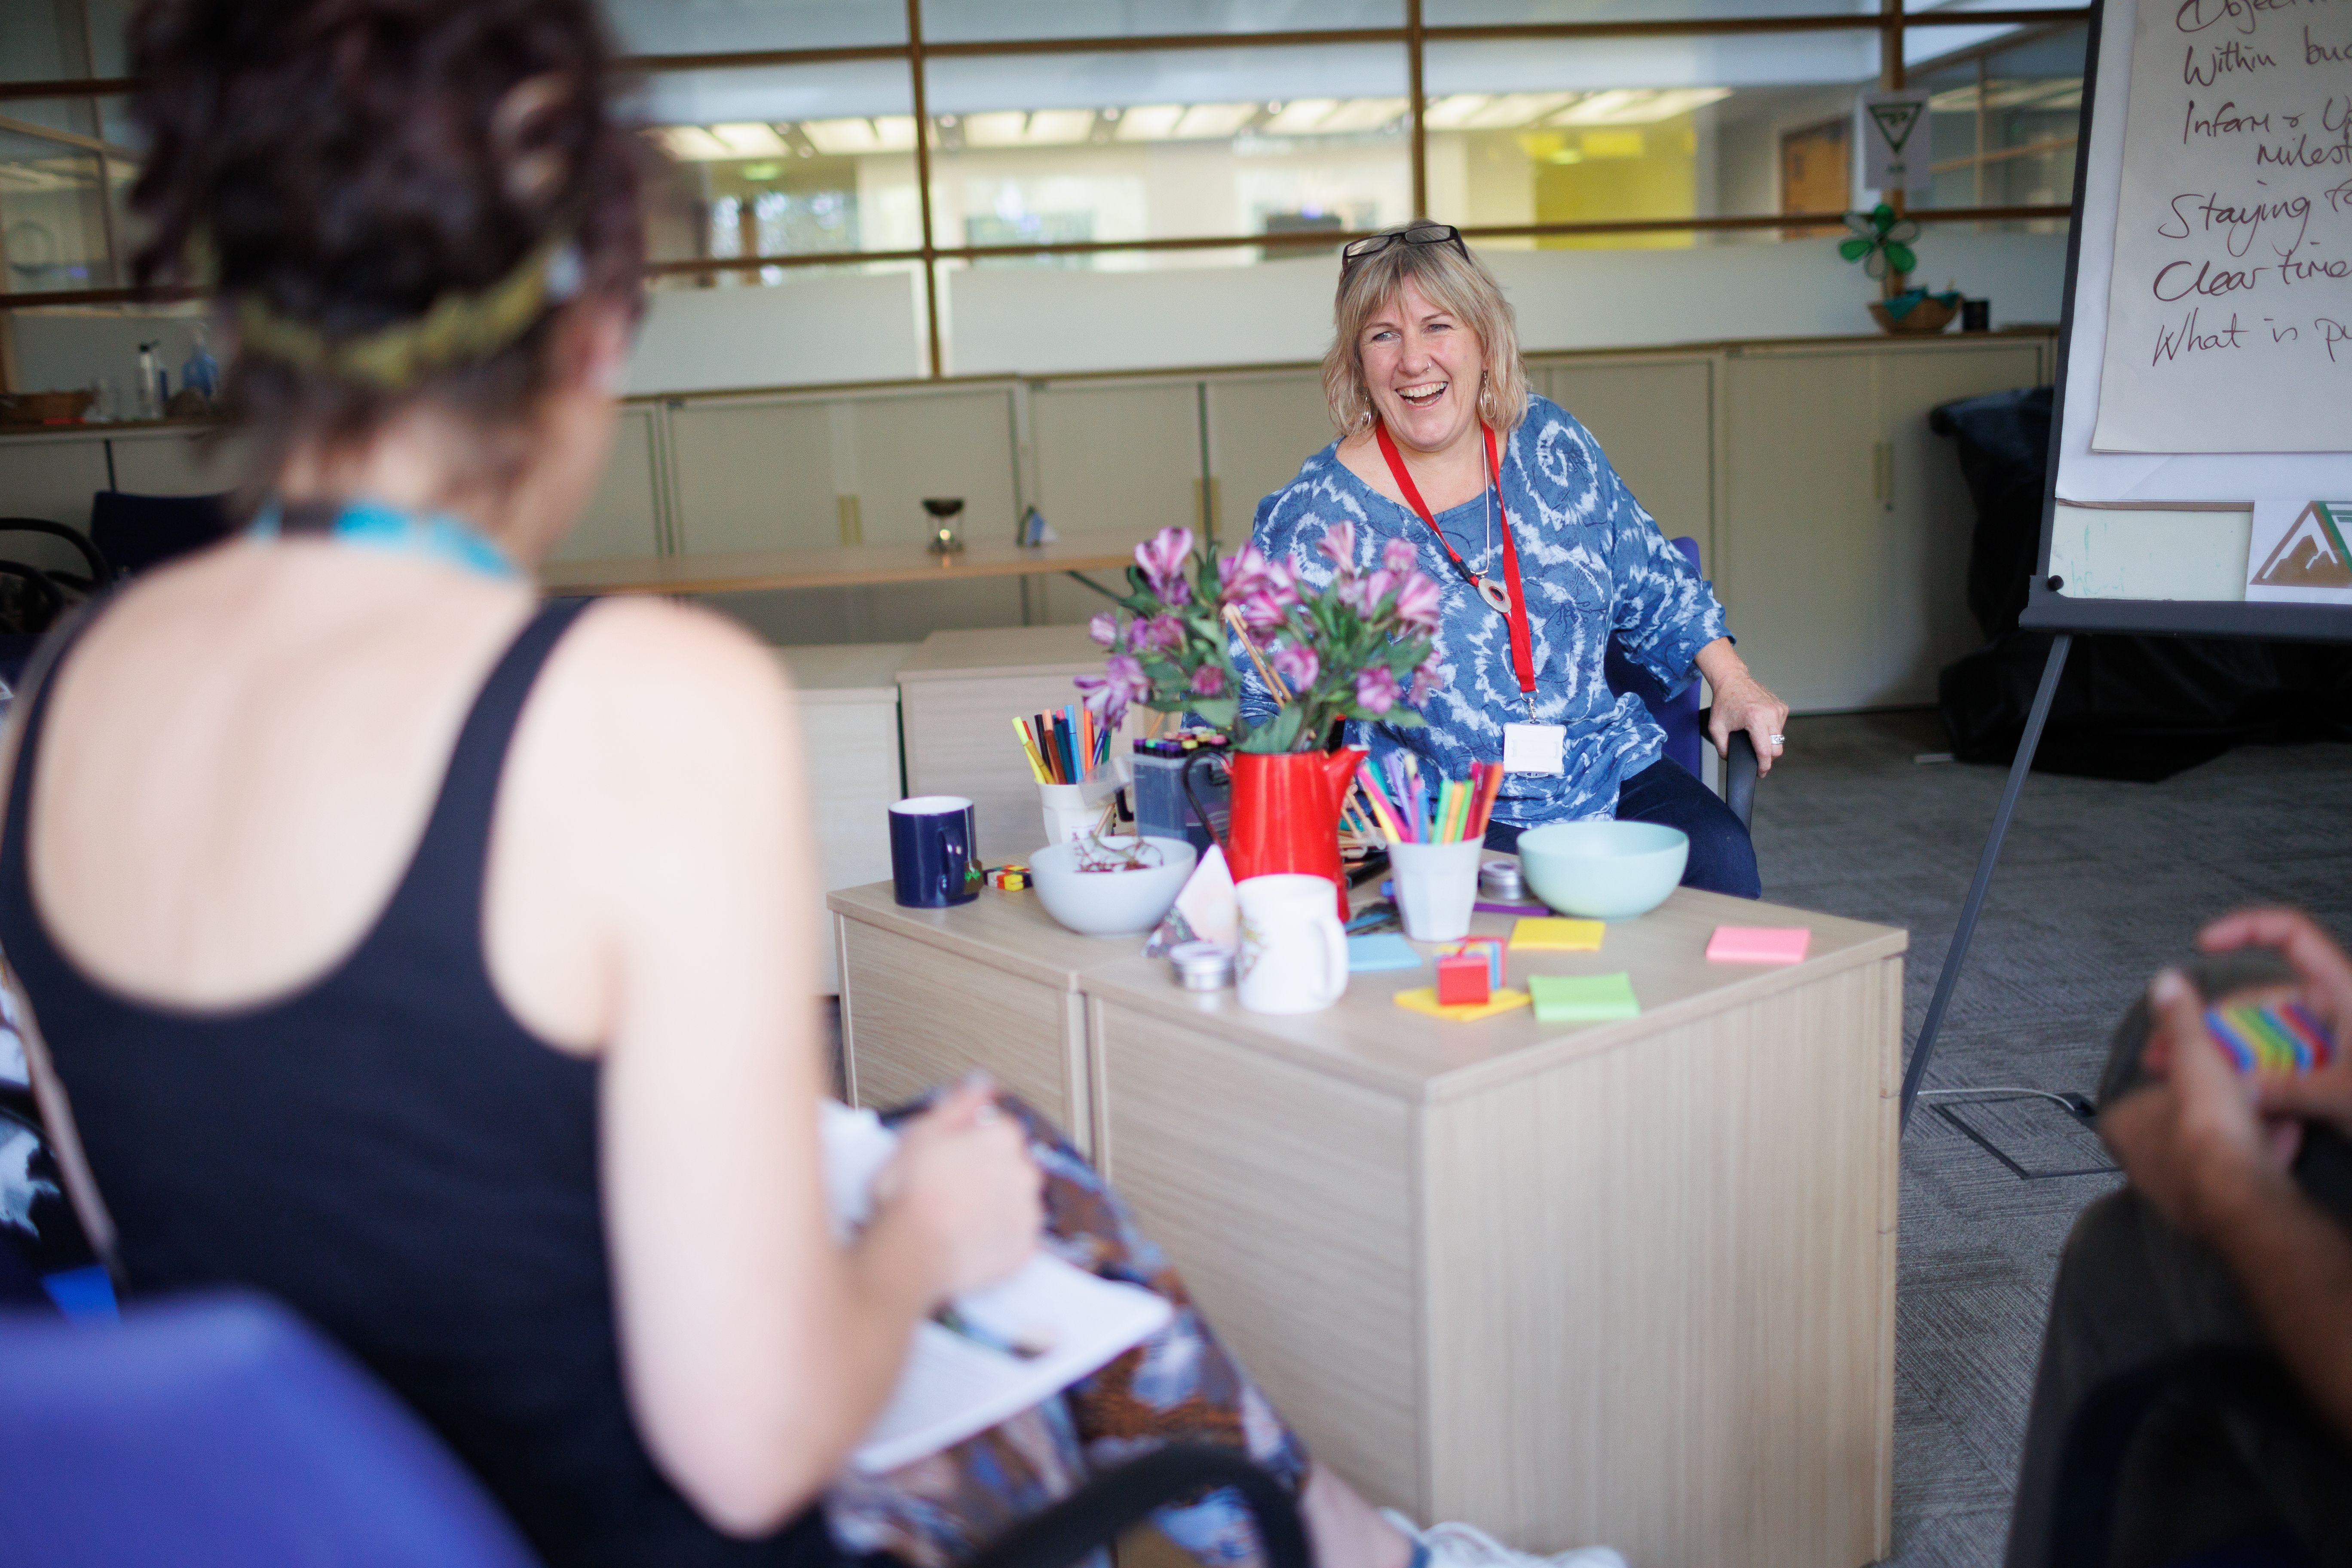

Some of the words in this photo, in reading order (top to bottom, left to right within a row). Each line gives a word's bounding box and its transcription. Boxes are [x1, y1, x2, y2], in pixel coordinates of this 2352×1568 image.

[2184, 41, 2277, 87] Within
[2157, 179, 2311, 257] Staying
[2153, 260, 2271, 302] Clear
[2152, 307, 2250, 368] What
[2263, 317, 2298, 343] is
